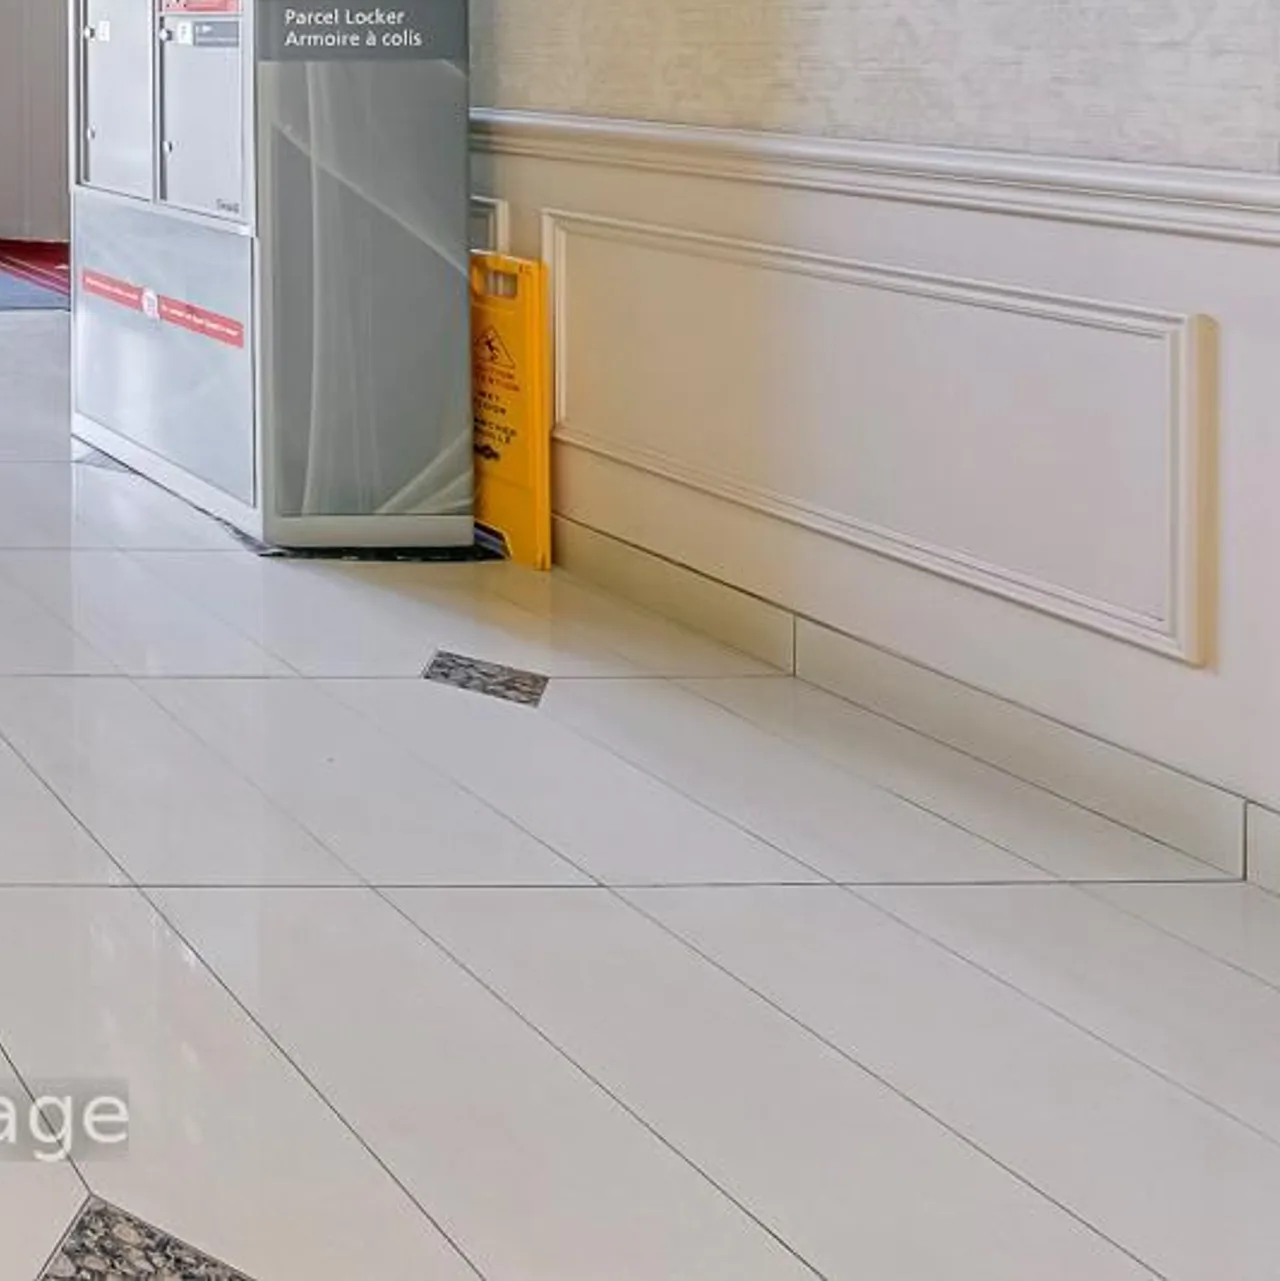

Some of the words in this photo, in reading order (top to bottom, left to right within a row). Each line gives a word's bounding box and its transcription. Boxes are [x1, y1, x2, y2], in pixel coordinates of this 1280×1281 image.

[284, 8, 339, 26] Parcel
[345, 7, 405, 25] Locker
[284, 30, 360, 47] Armoire
[365, 30, 377, 47] à
[382, 29, 423, 47] colis
